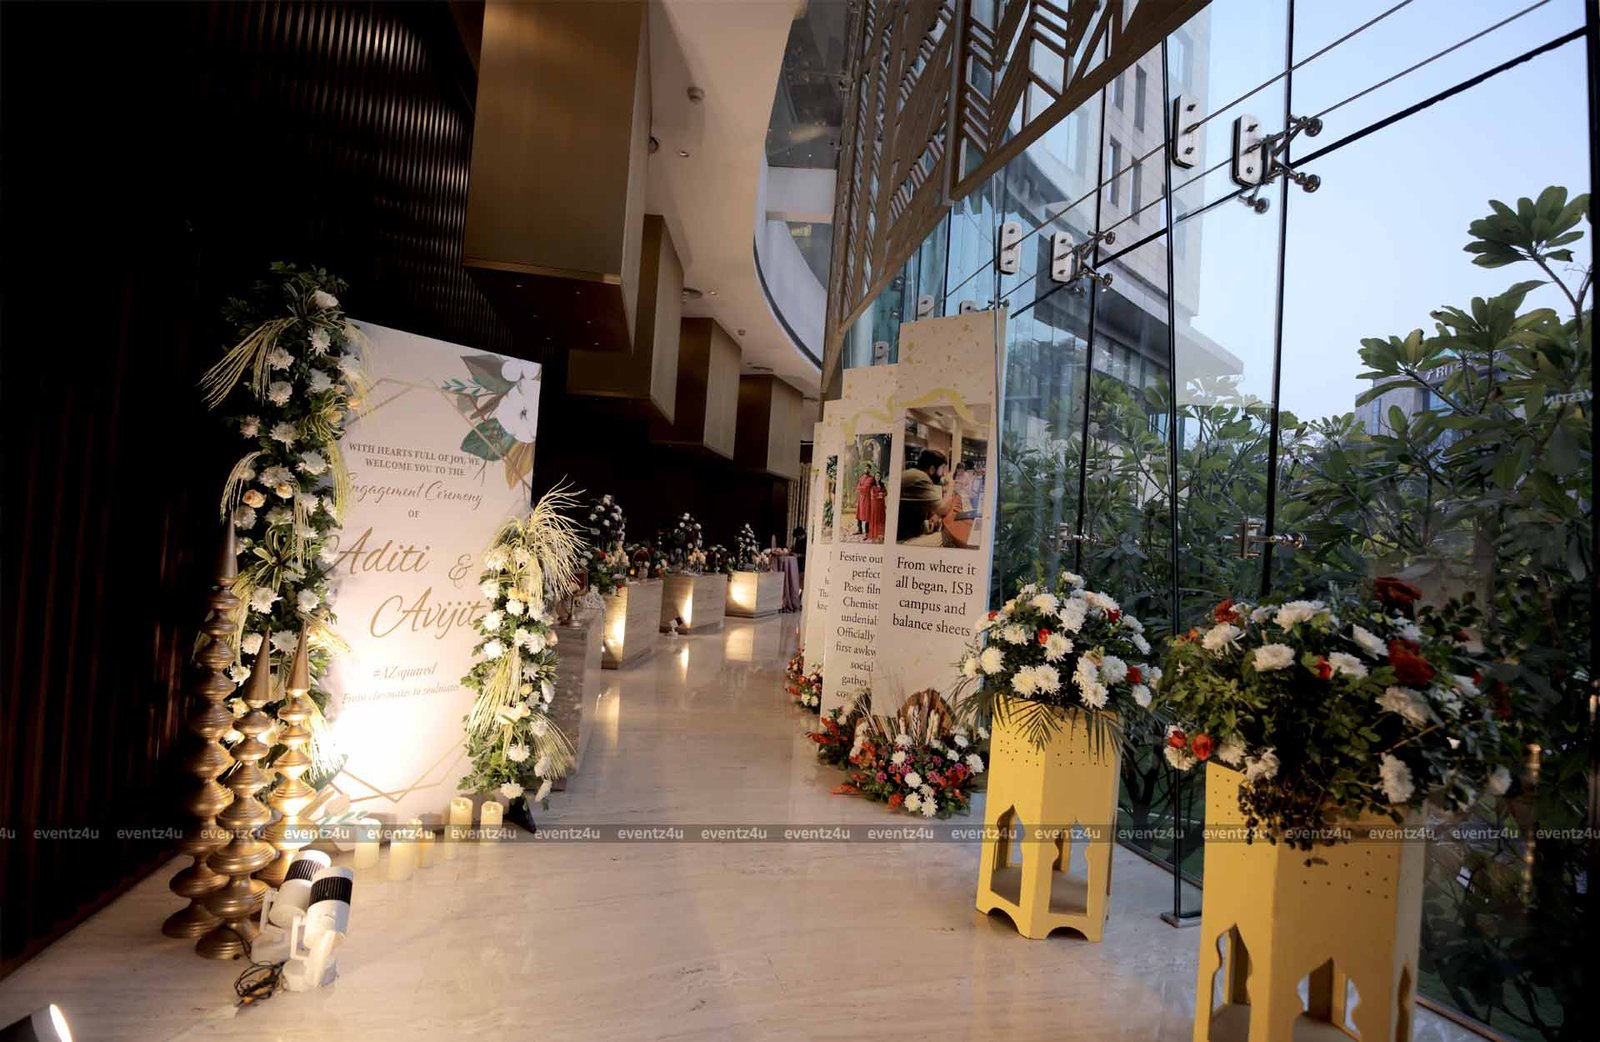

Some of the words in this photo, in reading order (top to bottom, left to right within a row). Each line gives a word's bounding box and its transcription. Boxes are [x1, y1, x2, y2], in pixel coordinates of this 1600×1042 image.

[349, 442, 375, 454] WITH
[377, 446, 413, 458] HEARTS
[414, 450, 436, 461] FULL
[438, 453, 449, 462] OF
[468, 455, 481, 466] WE
[365, 457, 412, 472] WELCOME
[413, 463, 432, 473] YOU
[434, 466, 446, 475] TO
[448, 467, 466, 477] THE
[425, 480, 483, 511] Ceremony
[408, 508, 421, 519] OF
[324, 527, 430, 575] Aditi
[448, 553, 474, 589] &
[839, 551, 867, 563] Festive
[896, 556, 926, 571] From
[929, 559, 963, 574] where
[967, 563, 977, 576] it
[895, 576, 908, 589] all
[911, 577, 948, 596] began,
[951, 580, 974, 596] ISB
[369, 586, 487, 640] Avijit
[899, 599, 941, 614] campus
[944, 602, 966, 616] and
[837, 626, 875, 643] Officially
[892, 613, 934, 631] balance
[936, 619, 971, 637] sheets
[835, 641, 852, 653] first
[850, 661, 874, 672] social
